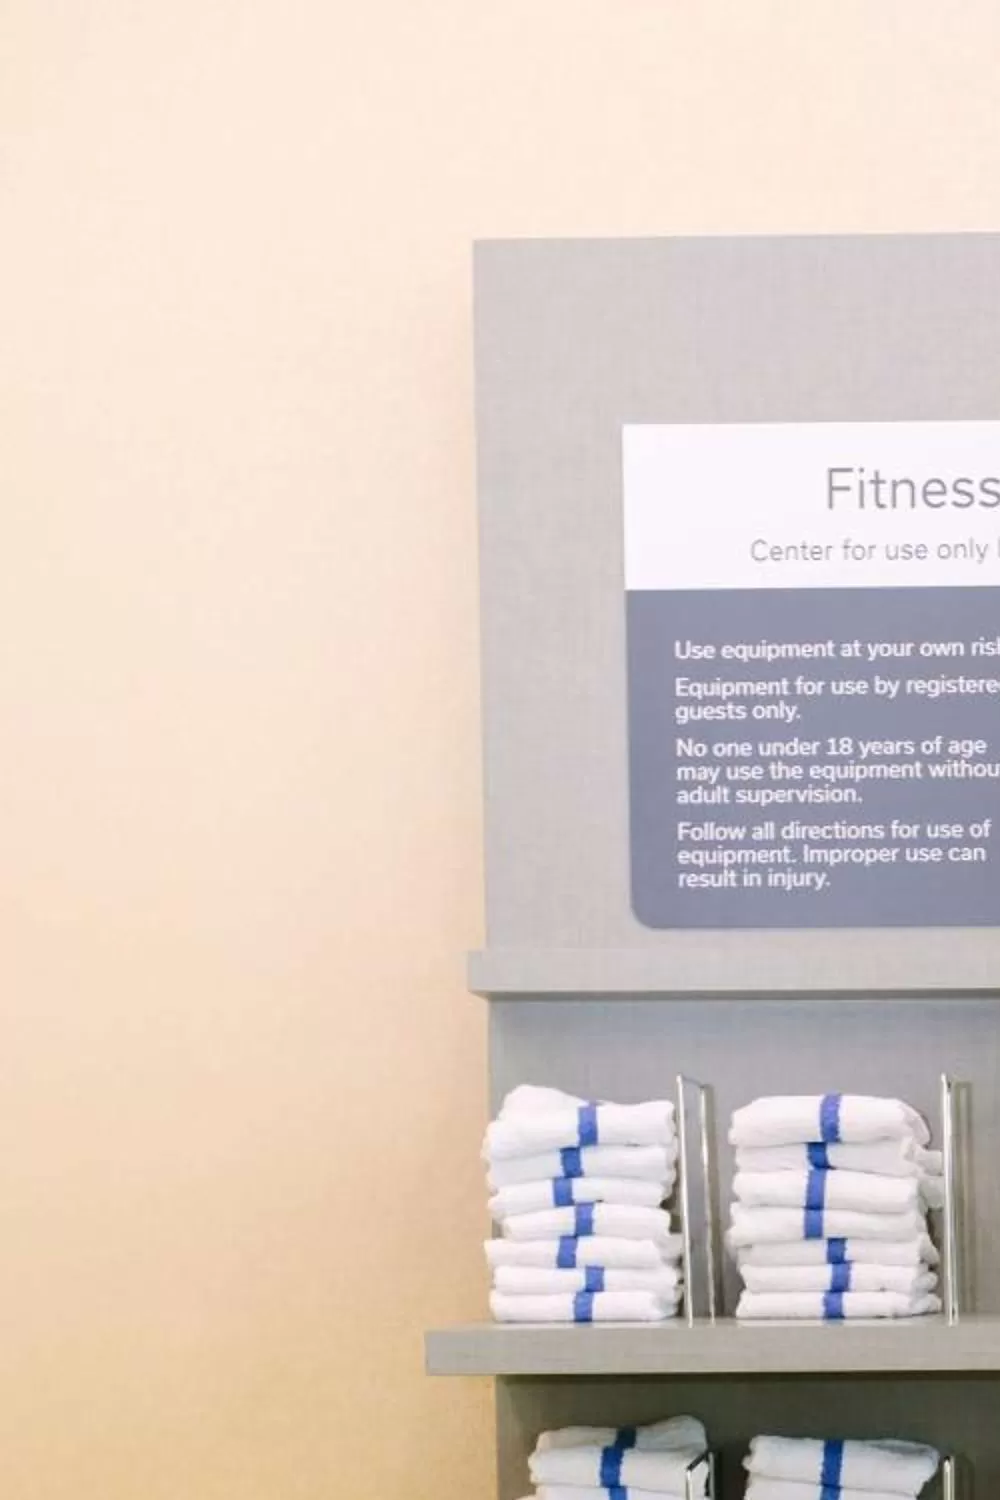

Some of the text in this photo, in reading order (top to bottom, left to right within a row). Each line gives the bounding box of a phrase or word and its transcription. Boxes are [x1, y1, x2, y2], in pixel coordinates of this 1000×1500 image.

[751, 538, 833, 562] Center
[842, 539, 877, 561] for
[885, 543, 929, 561] use
[937, 538, 989, 564] only
[674, 640, 716, 660] Use
[720, 639, 836, 663] equipment
[840, 639, 862, 658] at
[867, 642, 915, 662] your
[919, 641, 965, 657] own
[675, 677, 790, 700] Equipment
[793, 675, 826, 696] for
[830, 680, 869, 695] use
[874, 675, 901, 699] by
[674, 699, 801, 725] guests only.
[676, 735, 988, 760] No one under 18 years of age
[676, 765, 721, 785] may
[726, 765, 765, 781] use
[768, 760, 804, 780] the
[809, 761, 923, 783] equipment
[676, 783, 863, 807] adult supervision.
[677, 818, 992, 841] Follow all directions for use of
[677, 843, 986, 868] equipment. Improper use can
[678, 867, 831, 891] result in injury.
